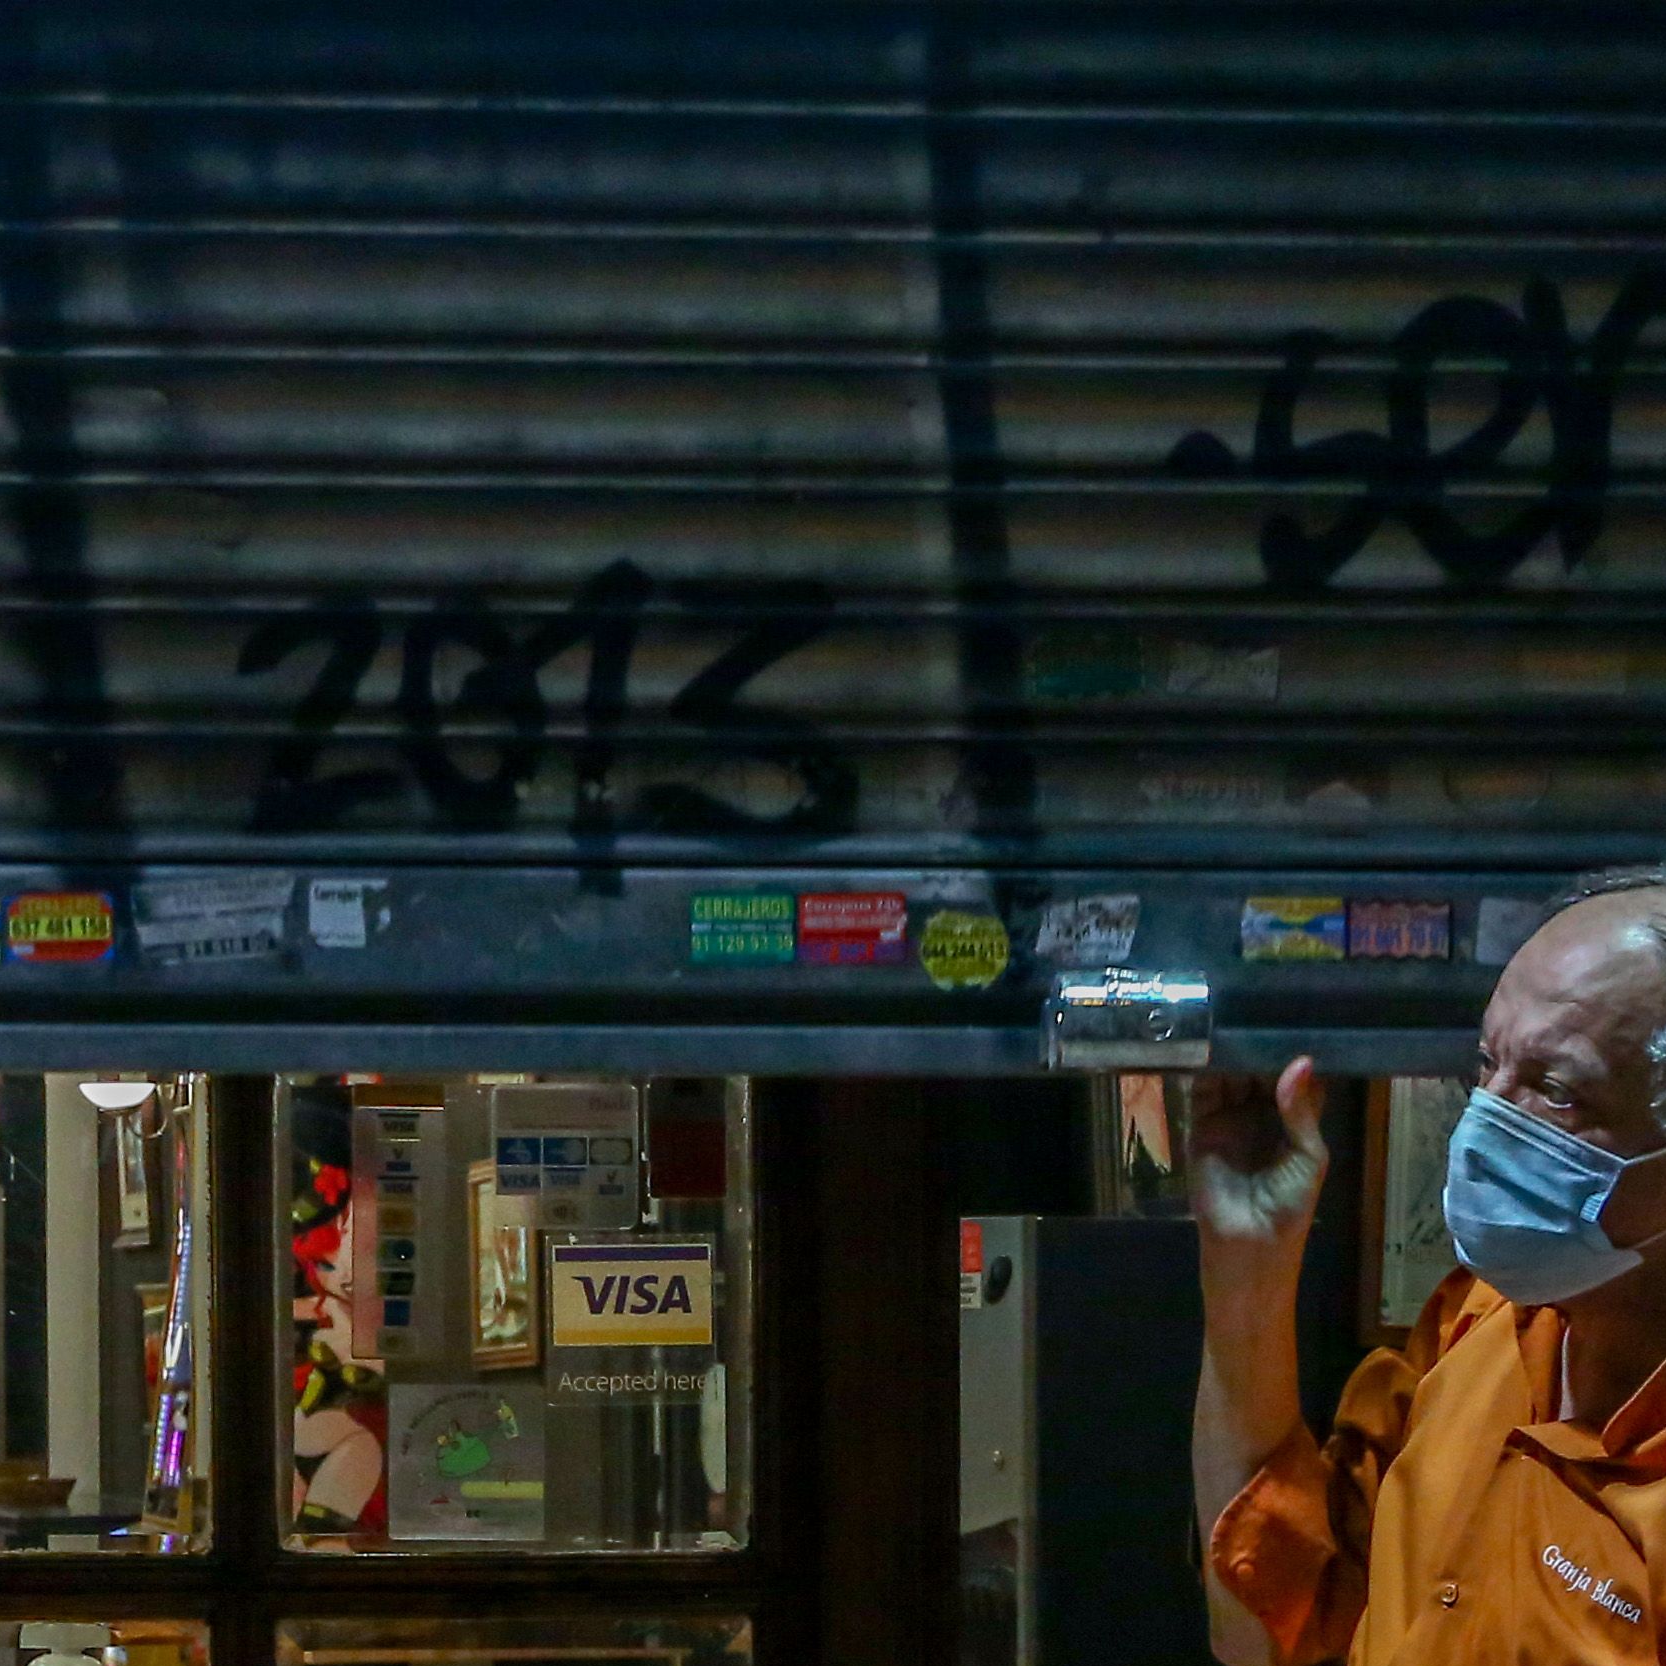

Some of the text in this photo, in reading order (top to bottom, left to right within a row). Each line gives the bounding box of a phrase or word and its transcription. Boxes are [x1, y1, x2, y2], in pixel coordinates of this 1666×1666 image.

[572, 1274, 693, 1315] VISA
[559, 1371, 707, 1394] Accepted here
[1541, 1544, 1642, 1625] Granja Blanca
